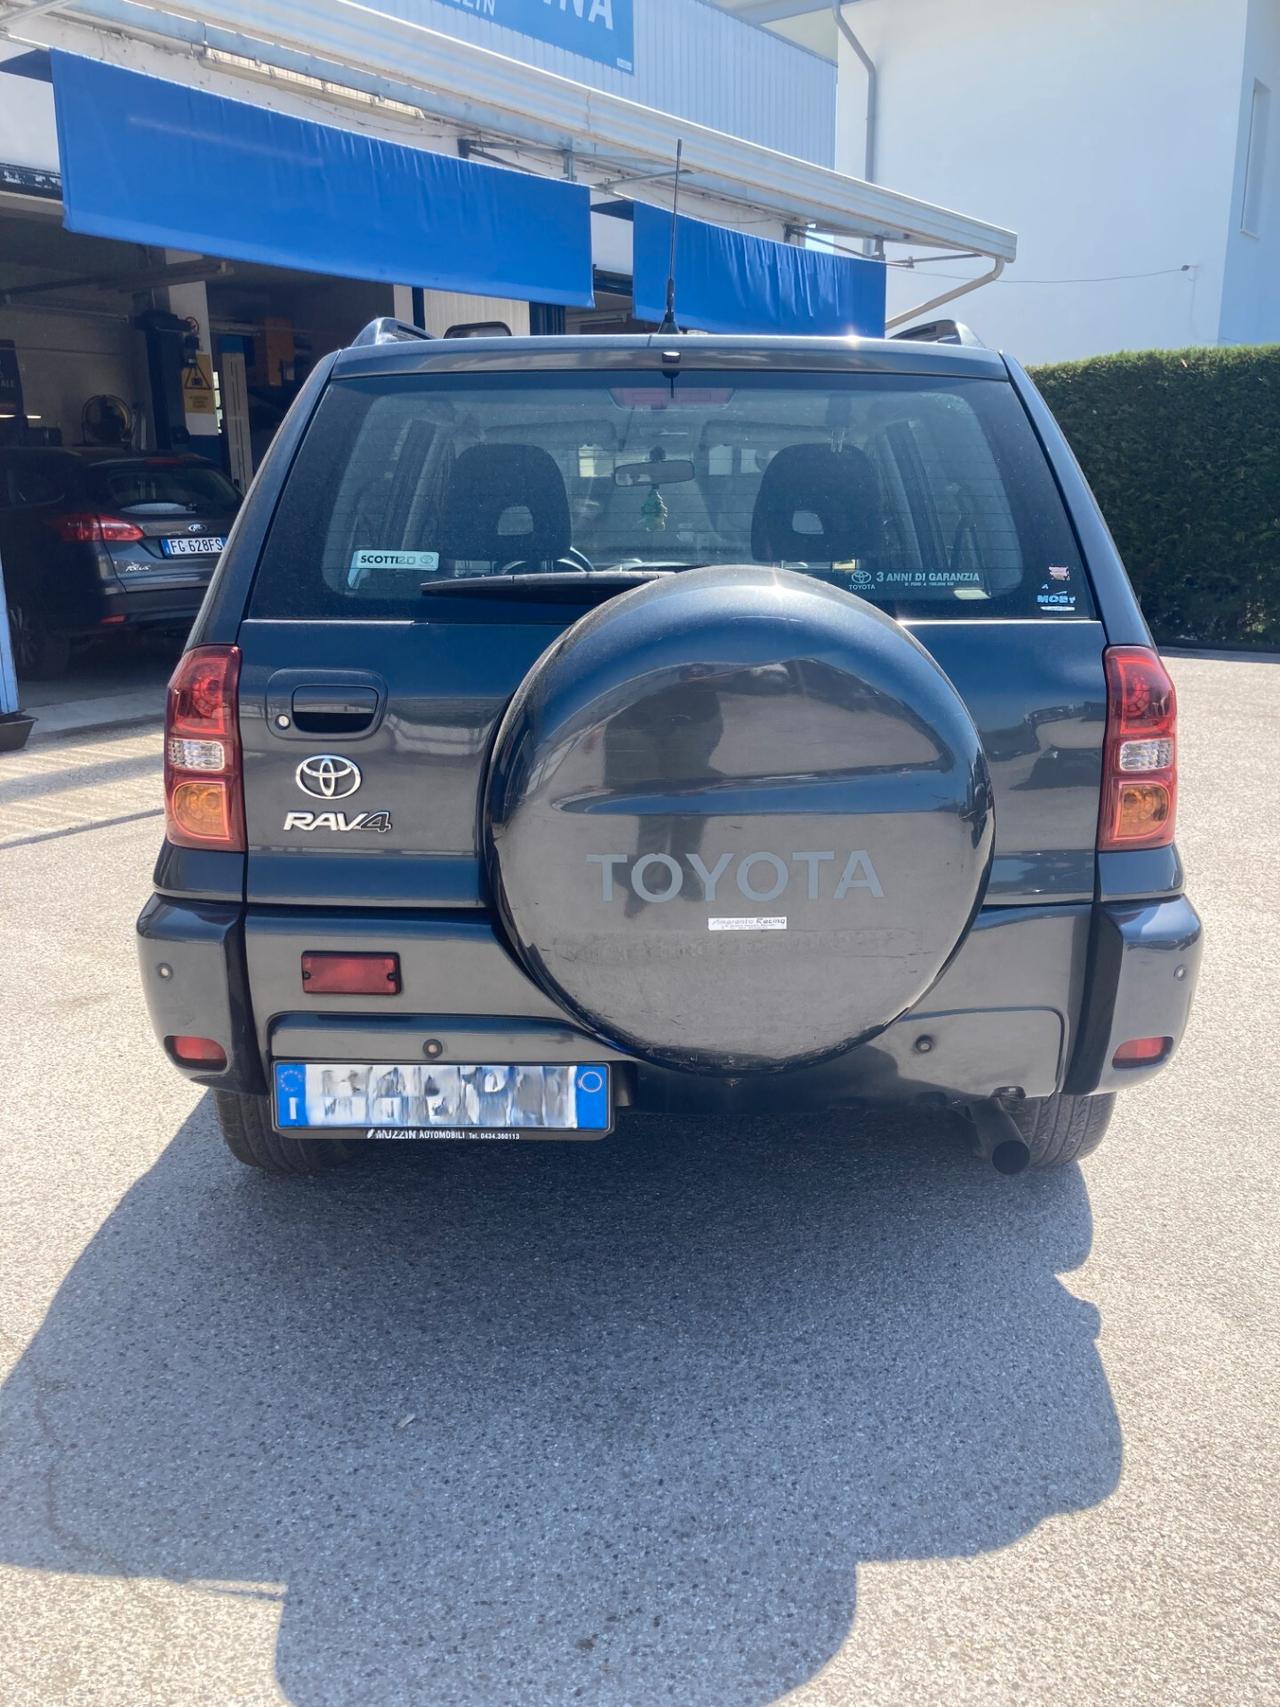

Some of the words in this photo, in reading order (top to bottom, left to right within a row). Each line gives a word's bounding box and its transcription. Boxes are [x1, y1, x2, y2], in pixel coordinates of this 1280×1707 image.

[170, 539, 186, 554] FG
[188, 538, 223, 553] 628FS
[876, 571, 885, 583] 3
[886, 572, 913, 582] ANNI
[914, 572, 926, 582] DI
[928, 572, 980, 582] GARANZIA
[283, 811, 392, 833] RAV4
[585, 850, 886, 903] TOYOTA
[418, 1130, 465, 1140] AUTOMOBILI
